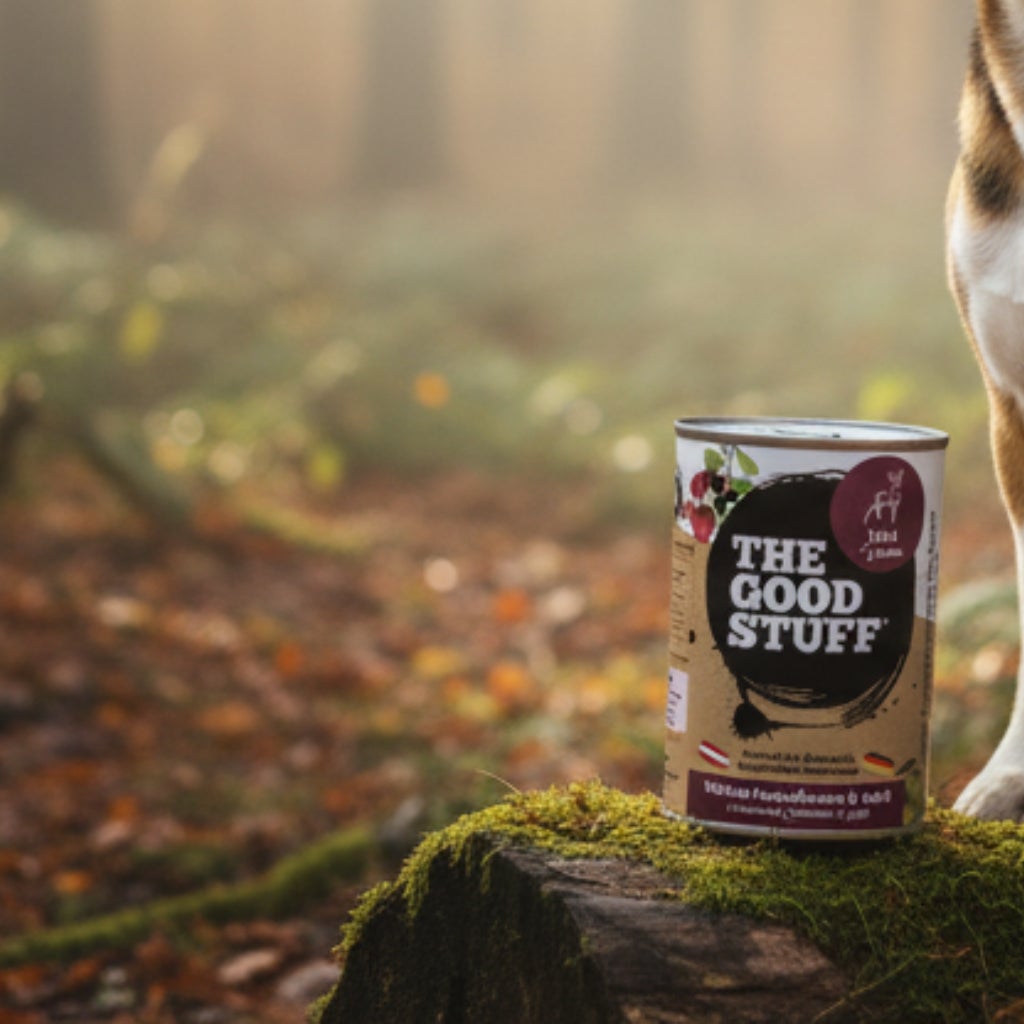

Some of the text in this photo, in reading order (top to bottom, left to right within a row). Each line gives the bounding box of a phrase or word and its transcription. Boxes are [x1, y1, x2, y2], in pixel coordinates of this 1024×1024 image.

[731, 534, 827, 576] THE
[729, 572, 863, 615] GOOD
[727, 611, 882, 653] STUFF
